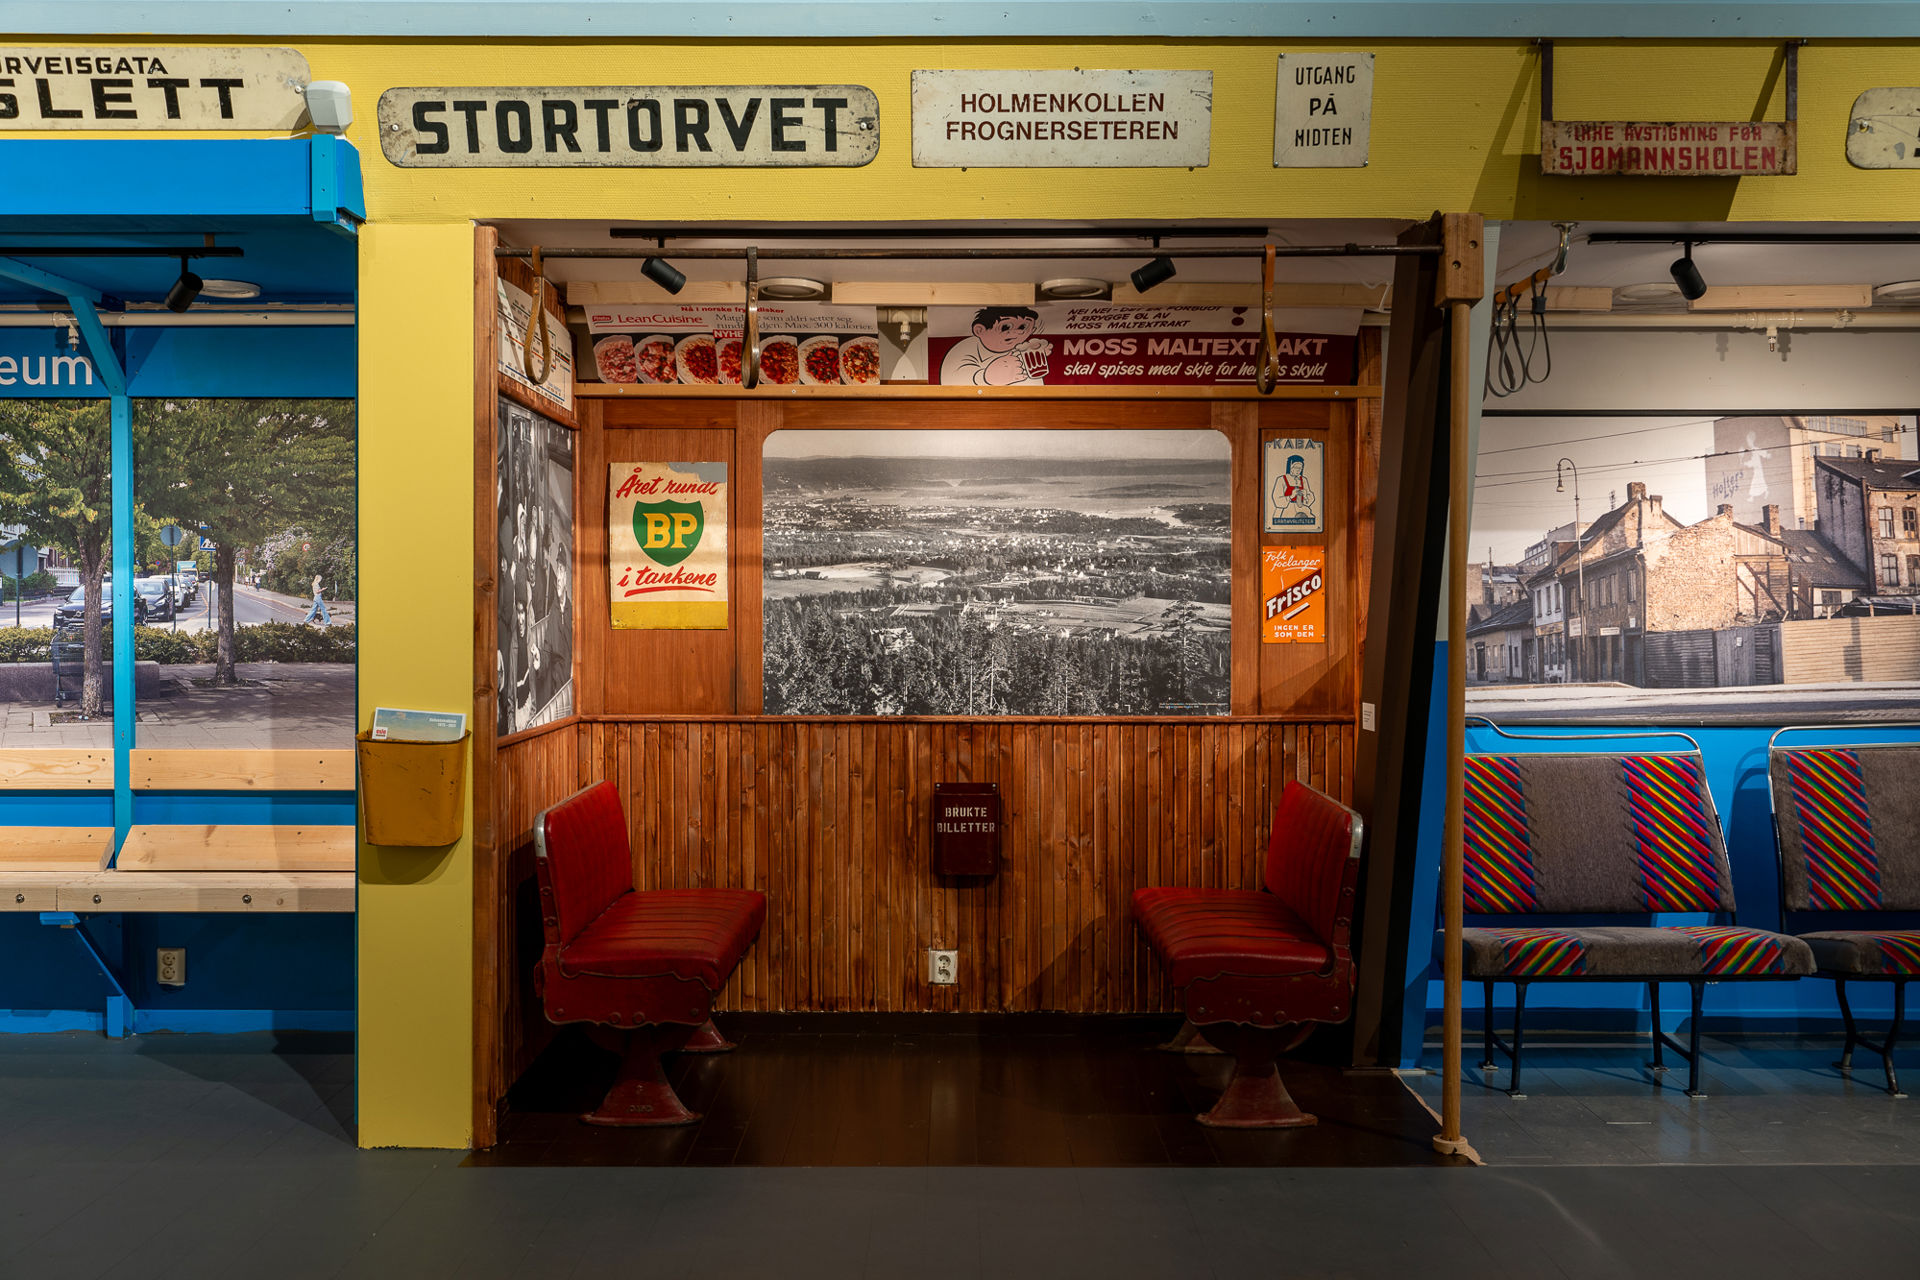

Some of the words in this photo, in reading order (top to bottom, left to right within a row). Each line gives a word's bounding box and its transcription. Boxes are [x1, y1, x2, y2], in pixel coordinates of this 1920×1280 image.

[0, 56, 168, 75] RVEISGATA
[1296, 66, 1355, 86] UTGANG
[961, 93, 1165, 113] HOLMENKOLLEN
[1309, 93, 1337, 116] PÅ
[411, 98, 848, 155] STORTORVET
[946, 120, 1179, 141] FROGNERSETEREN
[1624, 126, 1718, 141] AVSTIGNING
[1729, 126, 1762, 141] FØR
[1295, 127, 1351, 147] MIDTEN
[1559, 146, 1776, 170] SJØMANNSKOLEN
[735, 306, 785, 314] frydisker
[786, 314, 807, 322] aldri
[810, 315, 834, 323] setter
[837, 316, 852, 324] seg
[1081, 314, 1131, 322] BRYGGE
[1134, 312, 1149, 320] ØL
[1153, 311, 1171, 319] AV
[815, 322, 833, 330] 300
[1066, 322, 1102, 330] MOSS
[1107, 320, 1191, 329] MALTEXTRAKT
[1064, 338, 1137, 356] MOSS
[1148, 338, 1329, 356] MALTEXTAKT
[0, 355, 93, 386] eum
[1064, 361, 1096, 376] skal
[1098, 364, 1144, 378] spises
[1149, 361, 1180, 376] med
[1184, 361, 1212, 378] skje
[1215, 362, 1237, 378] for
[1290, 362, 1328, 379] skyld
[1273, 438, 1316, 450] KABA
[616, 467, 664, 498] Året
[642, 512, 698, 549] BP
[1265, 551, 1287, 563] Folk
[617, 567, 632, 587] i
[635, 565, 717, 586] tankene
[1266, 574, 1322, 619] Frisco
[945, 807, 988, 818] BRUKTE
[937, 822, 996, 833] BILLETTER
